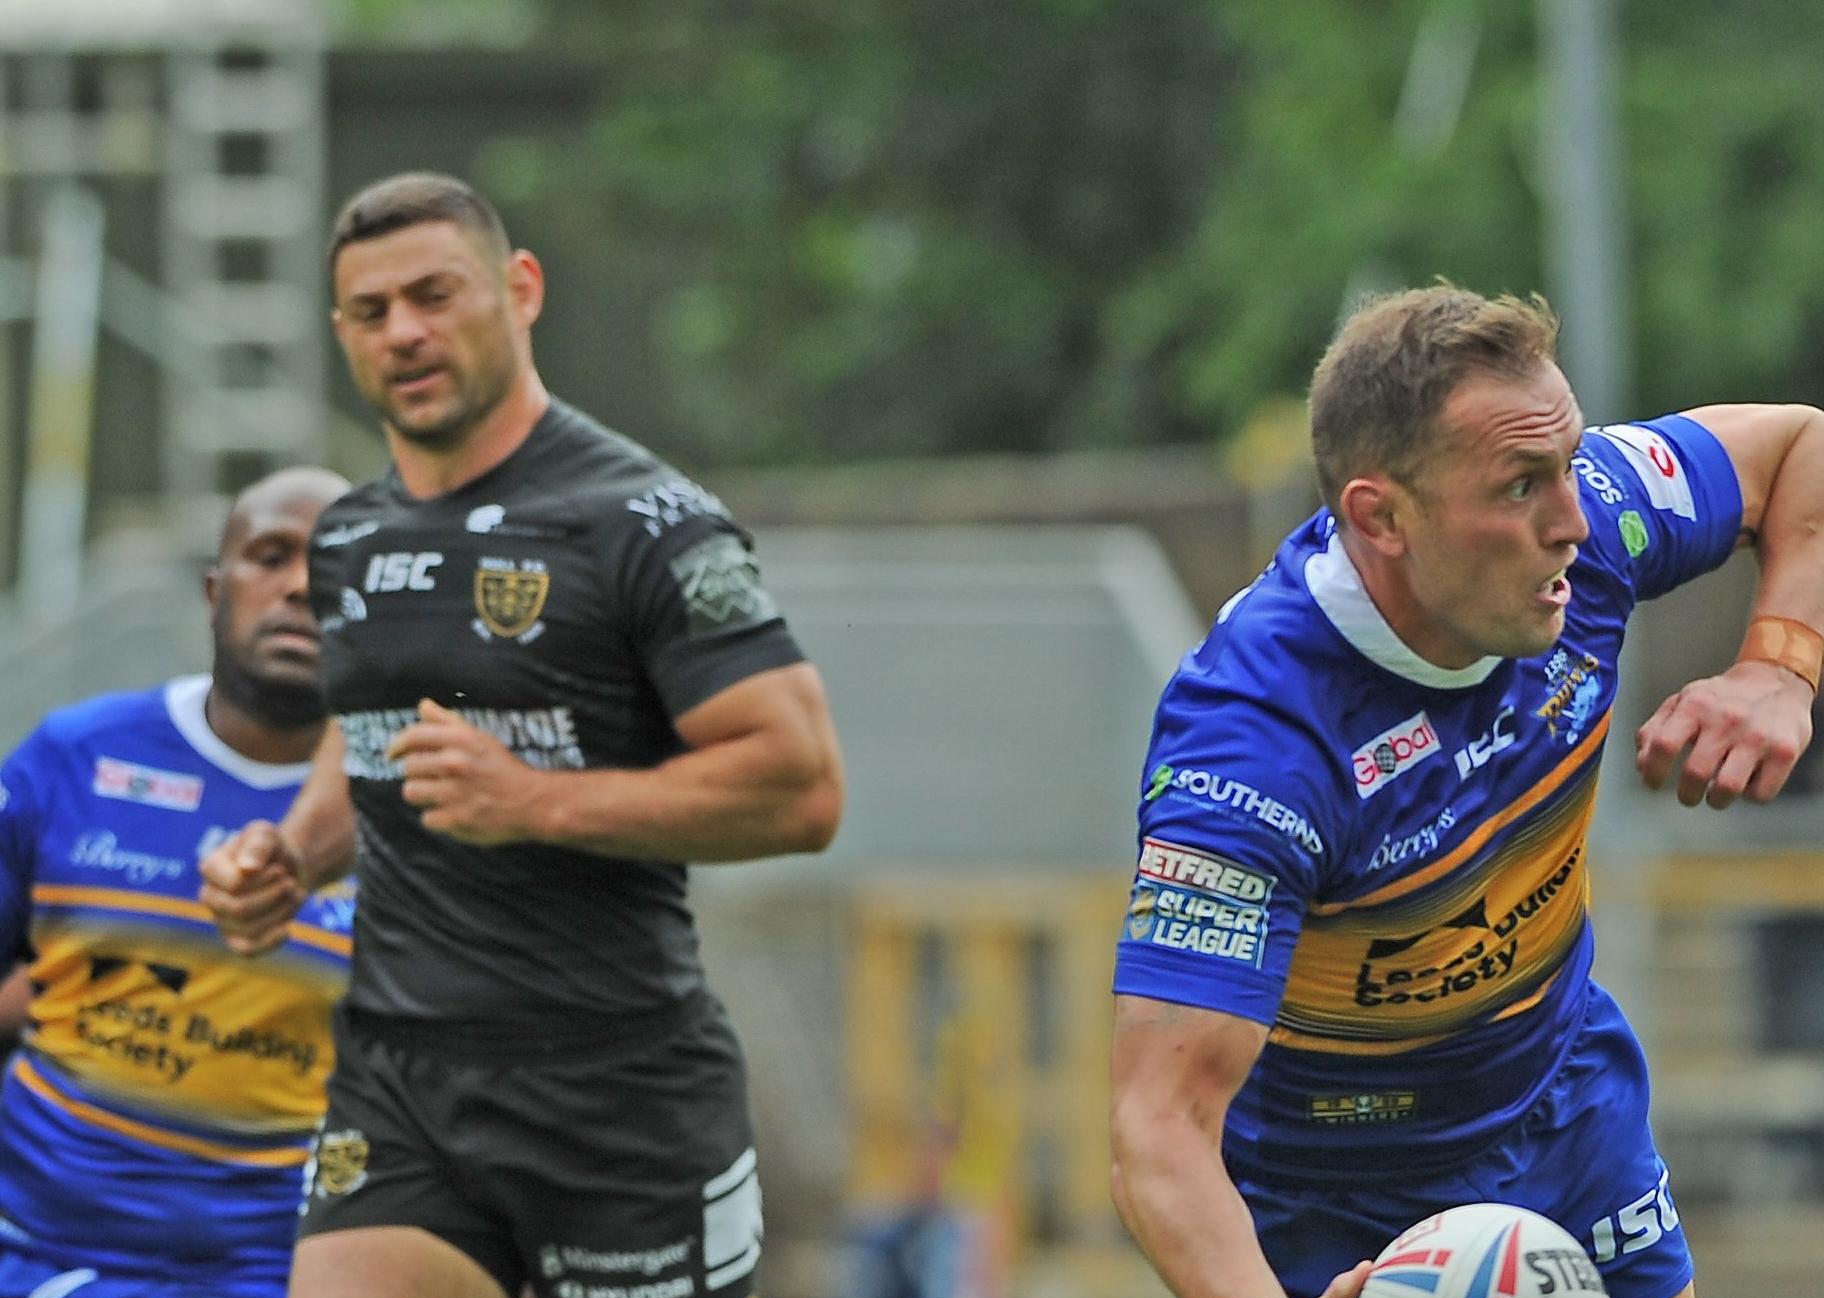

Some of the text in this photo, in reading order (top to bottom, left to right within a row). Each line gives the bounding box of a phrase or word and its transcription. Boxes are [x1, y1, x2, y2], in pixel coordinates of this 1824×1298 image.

[364, 552, 444, 594] ISC
[1156, 889, 1262, 933] SUPER
[1152, 919, 1258, 961] LEAGUE
